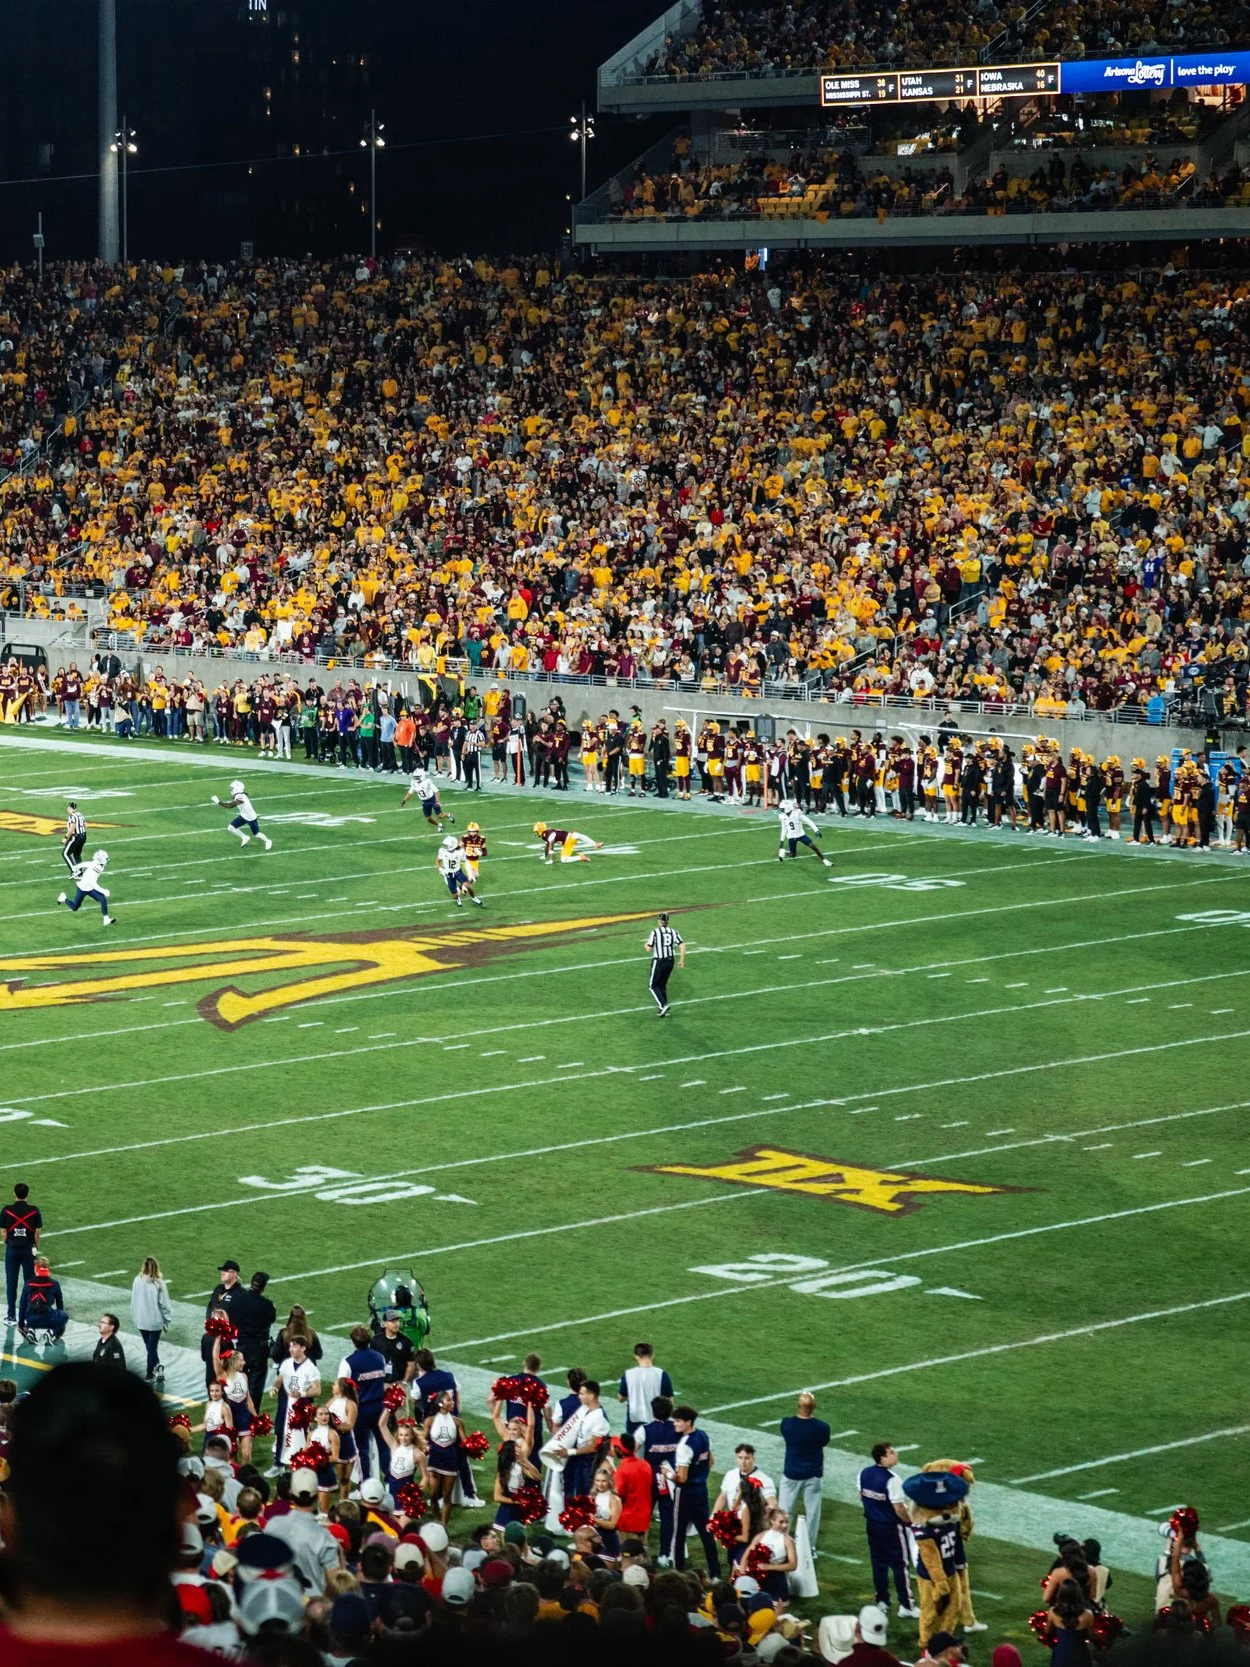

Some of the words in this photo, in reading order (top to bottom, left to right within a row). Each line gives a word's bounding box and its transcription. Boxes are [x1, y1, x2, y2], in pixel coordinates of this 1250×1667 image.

[981, 72, 1002, 82] IOWA
[1036, 69, 1045, 78] 40
[1048, 75, 1054, 84] F
[1104, 66, 1136, 78] Arizona
[1128, 60, 1166, 86] Lottery
[1177, 67, 1197, 77] love
[1197, 65, 1213, 76] the
[1214, 64, 1235, 77] play
[825, 80, 840, 90] OLE
[841, 79, 860, 89] MISS
[877, 79, 886, 87] 38
[901, 77, 922, 86] UTAH
[955, 74, 964, 83] 31
[967, 79, 973, 88] F
[981, 81, 1023, 93] NEBRASKA
[1036, 80, 1045, 89] 16
[825, 91, 861, 100] MISSISSIPPI
[877, 90, 886, 98] 19
[902, 86, 933, 97] KANSAS
[955, 85, 964, 94] 21
[788, 821, 796, 831] 9
[448, 859, 456, 869] 12
[661, 932, 673, 946] B
[237, 1165, 436, 1205] 30
[687, 1252, 922, 1300] 20
